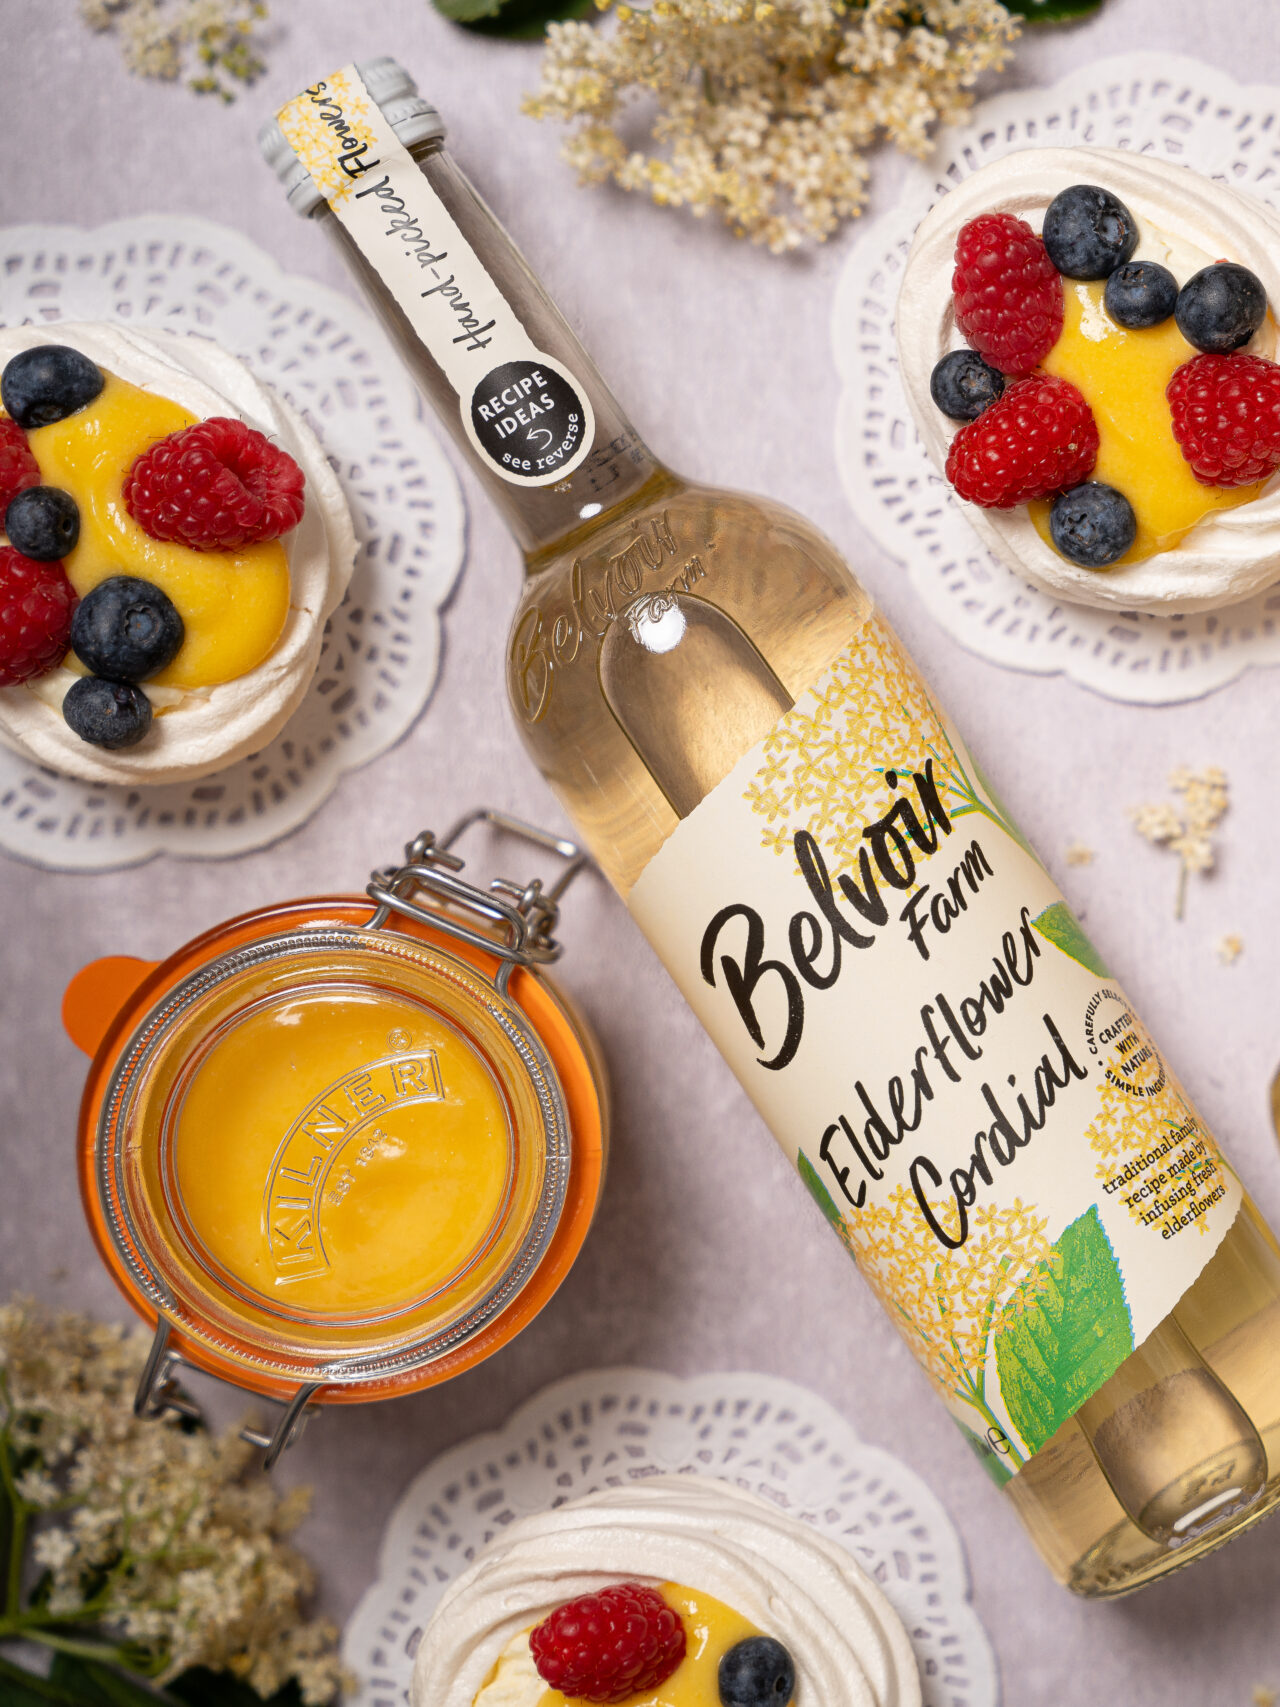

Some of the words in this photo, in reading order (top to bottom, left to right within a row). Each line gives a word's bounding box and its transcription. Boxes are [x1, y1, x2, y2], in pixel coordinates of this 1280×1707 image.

[305, 81, 380, 179] Flowers
[356, 175, 497, 351] Hand-picked
[477, 370, 549, 423] RECIPE
[494, 392, 556, 440] IDEAS
[502, 450, 532, 471] see
[536, 412, 579, 469] reverse
[700, 758, 953, 1071] Belvoir
[899, 840, 994, 961] Farm
[1084, 991, 1103, 1055] CAREFULLY
[1098, 1012, 1133, 1045] CRAFTED
[1115, 1032, 1140, 1055] WITH
[819, 906, 1041, 1209] Elderflower
[1104, 1069, 1145, 1097] SIMPLE
[1121, 1045, 1153, 1077] NATURE
[274, 1058, 429, 1265] KILNER
[908, 1013, 1088, 1249] Cordial
[1102, 1135, 1173, 1195] traditional
[1169, 1116, 1199, 1145] family
[1125, 1173, 1168, 1209] recipe
[1166, 1149, 1197, 1179] made
[1191, 1140, 1207, 1156] by
[1138, 1180, 1197, 1227] infusing
[1191, 1160, 1217, 1188] fresh
[1161, 1184, 1226, 1241] elderflowers
